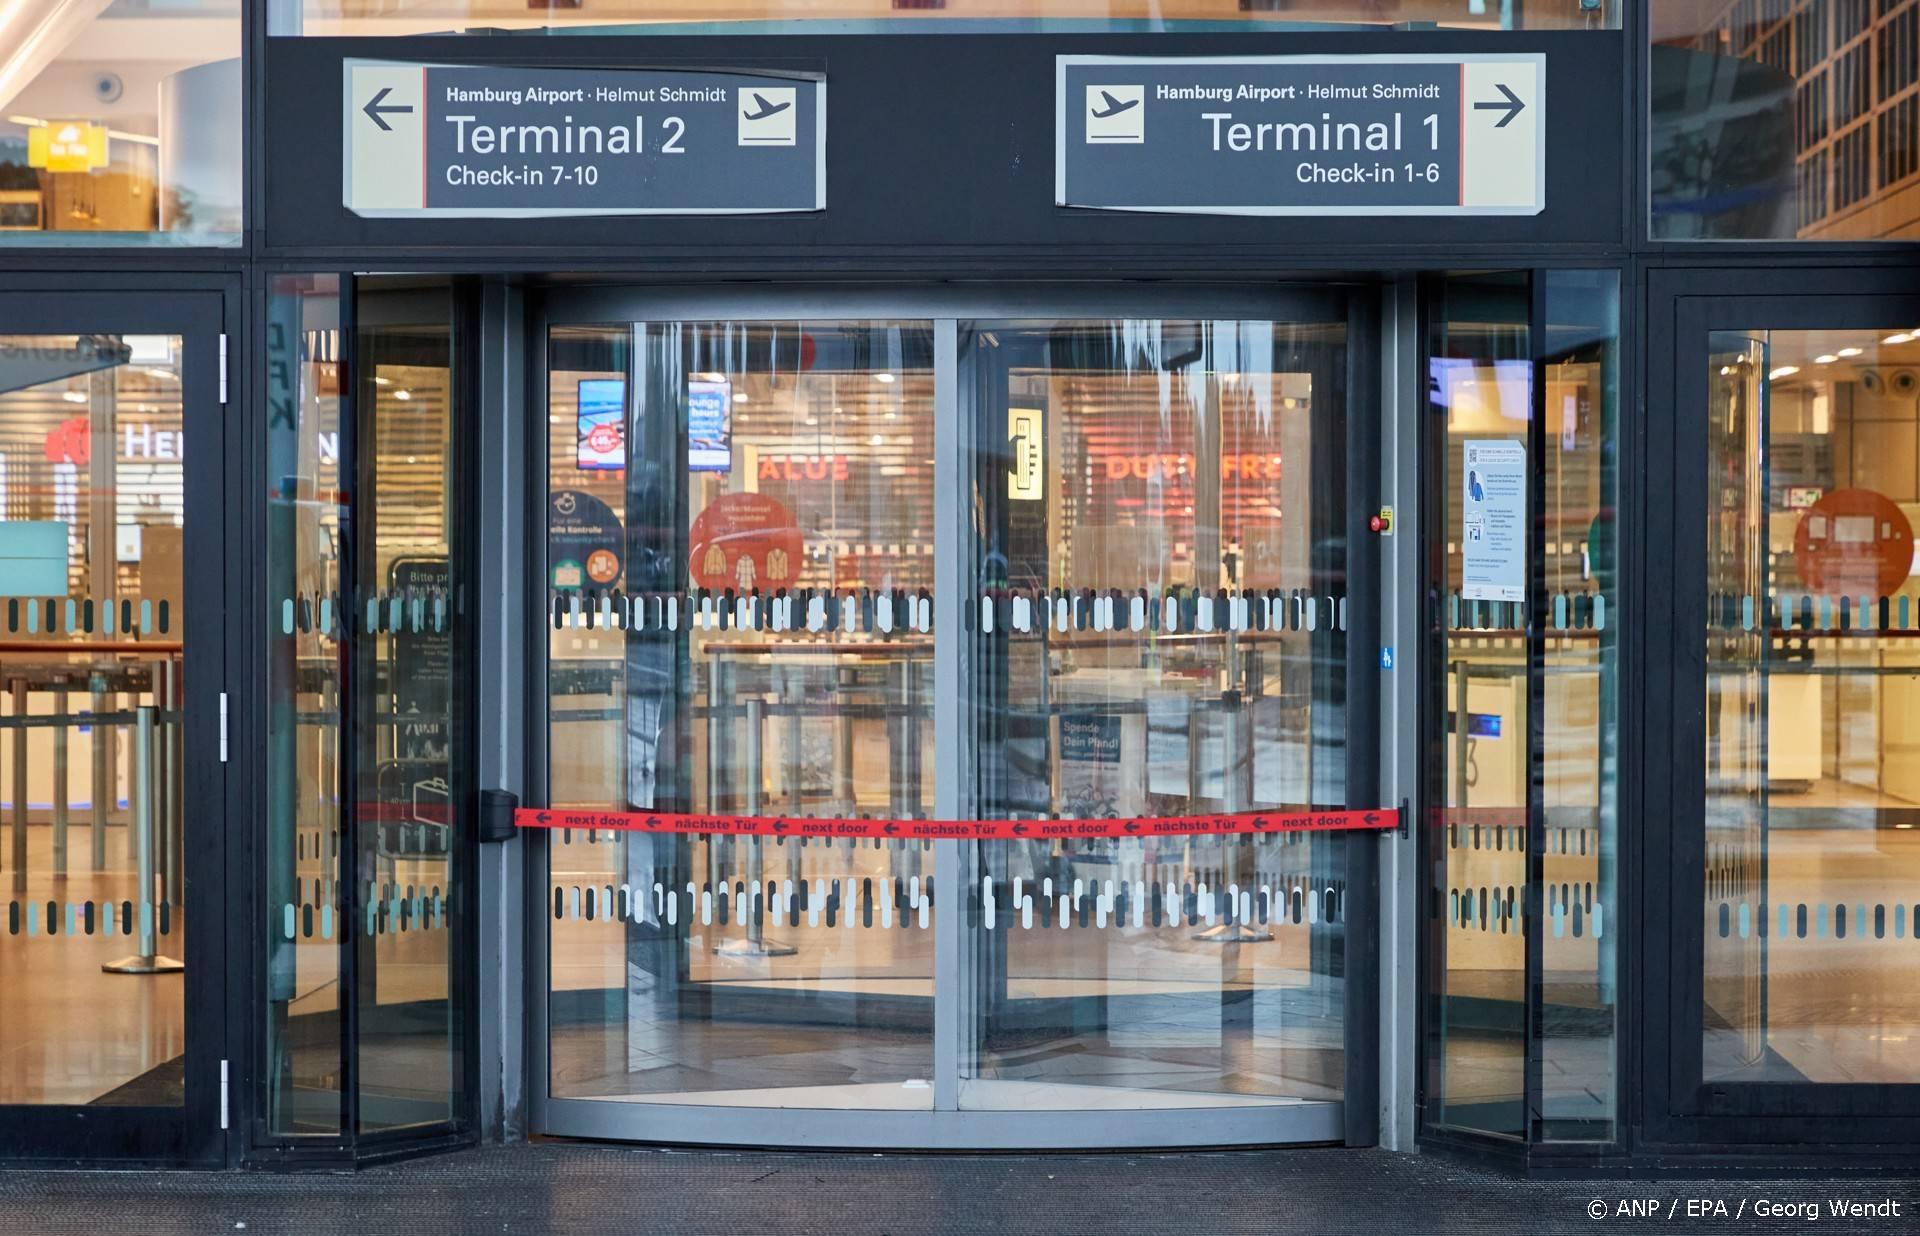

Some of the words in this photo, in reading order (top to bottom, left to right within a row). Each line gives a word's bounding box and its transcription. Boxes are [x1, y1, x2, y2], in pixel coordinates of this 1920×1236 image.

[445, 87, 522, 105] Hamburg
[525, 87, 583, 105] Airport
[596, 87, 655, 102] Helmut
[659, 87, 726, 102] Schmidt
[1156, 84, 1233, 102] Hamburg
[1236, 84, 1295, 102] Airport
[1307, 83, 1367, 98] Helmut
[1372, 83, 1440, 98] Schmidt
[445, 115, 643, 154] Terminal
[661, 116, 686, 153] 2
[1201, 112, 1402, 151] Terminal
[1422, 113, 1438, 150] 1
[446, 165, 543, 186] Check-in
[551, 166, 598, 186] 7-10
[1296, 162, 1395, 183] Check-in
[1404, 163, 1440, 183] 1-6
[758, 454, 849, 480] ALUE
[1063, 721, 1100, 734] Spende
[1063, 736, 1086, 748] Dein
[565, 815, 596, 825] next
[600, 815, 631, 827] door
[675, 819, 730, 831] nächste
[735, 820, 758, 831] Tür
[802, 823, 833, 834] next
[837, 822, 868, 834] door
[913, 823, 969, 835] nächste
[974, 824, 997, 835] Tür
[1042, 824, 1073, 834] next
[1077, 822, 1108, 833] door
[1153, 820, 1210, 832] nächste
[1215, 819, 1237, 830] Tür
[1282, 817, 1313, 828] next
[1317, 815, 1349, 827] door
